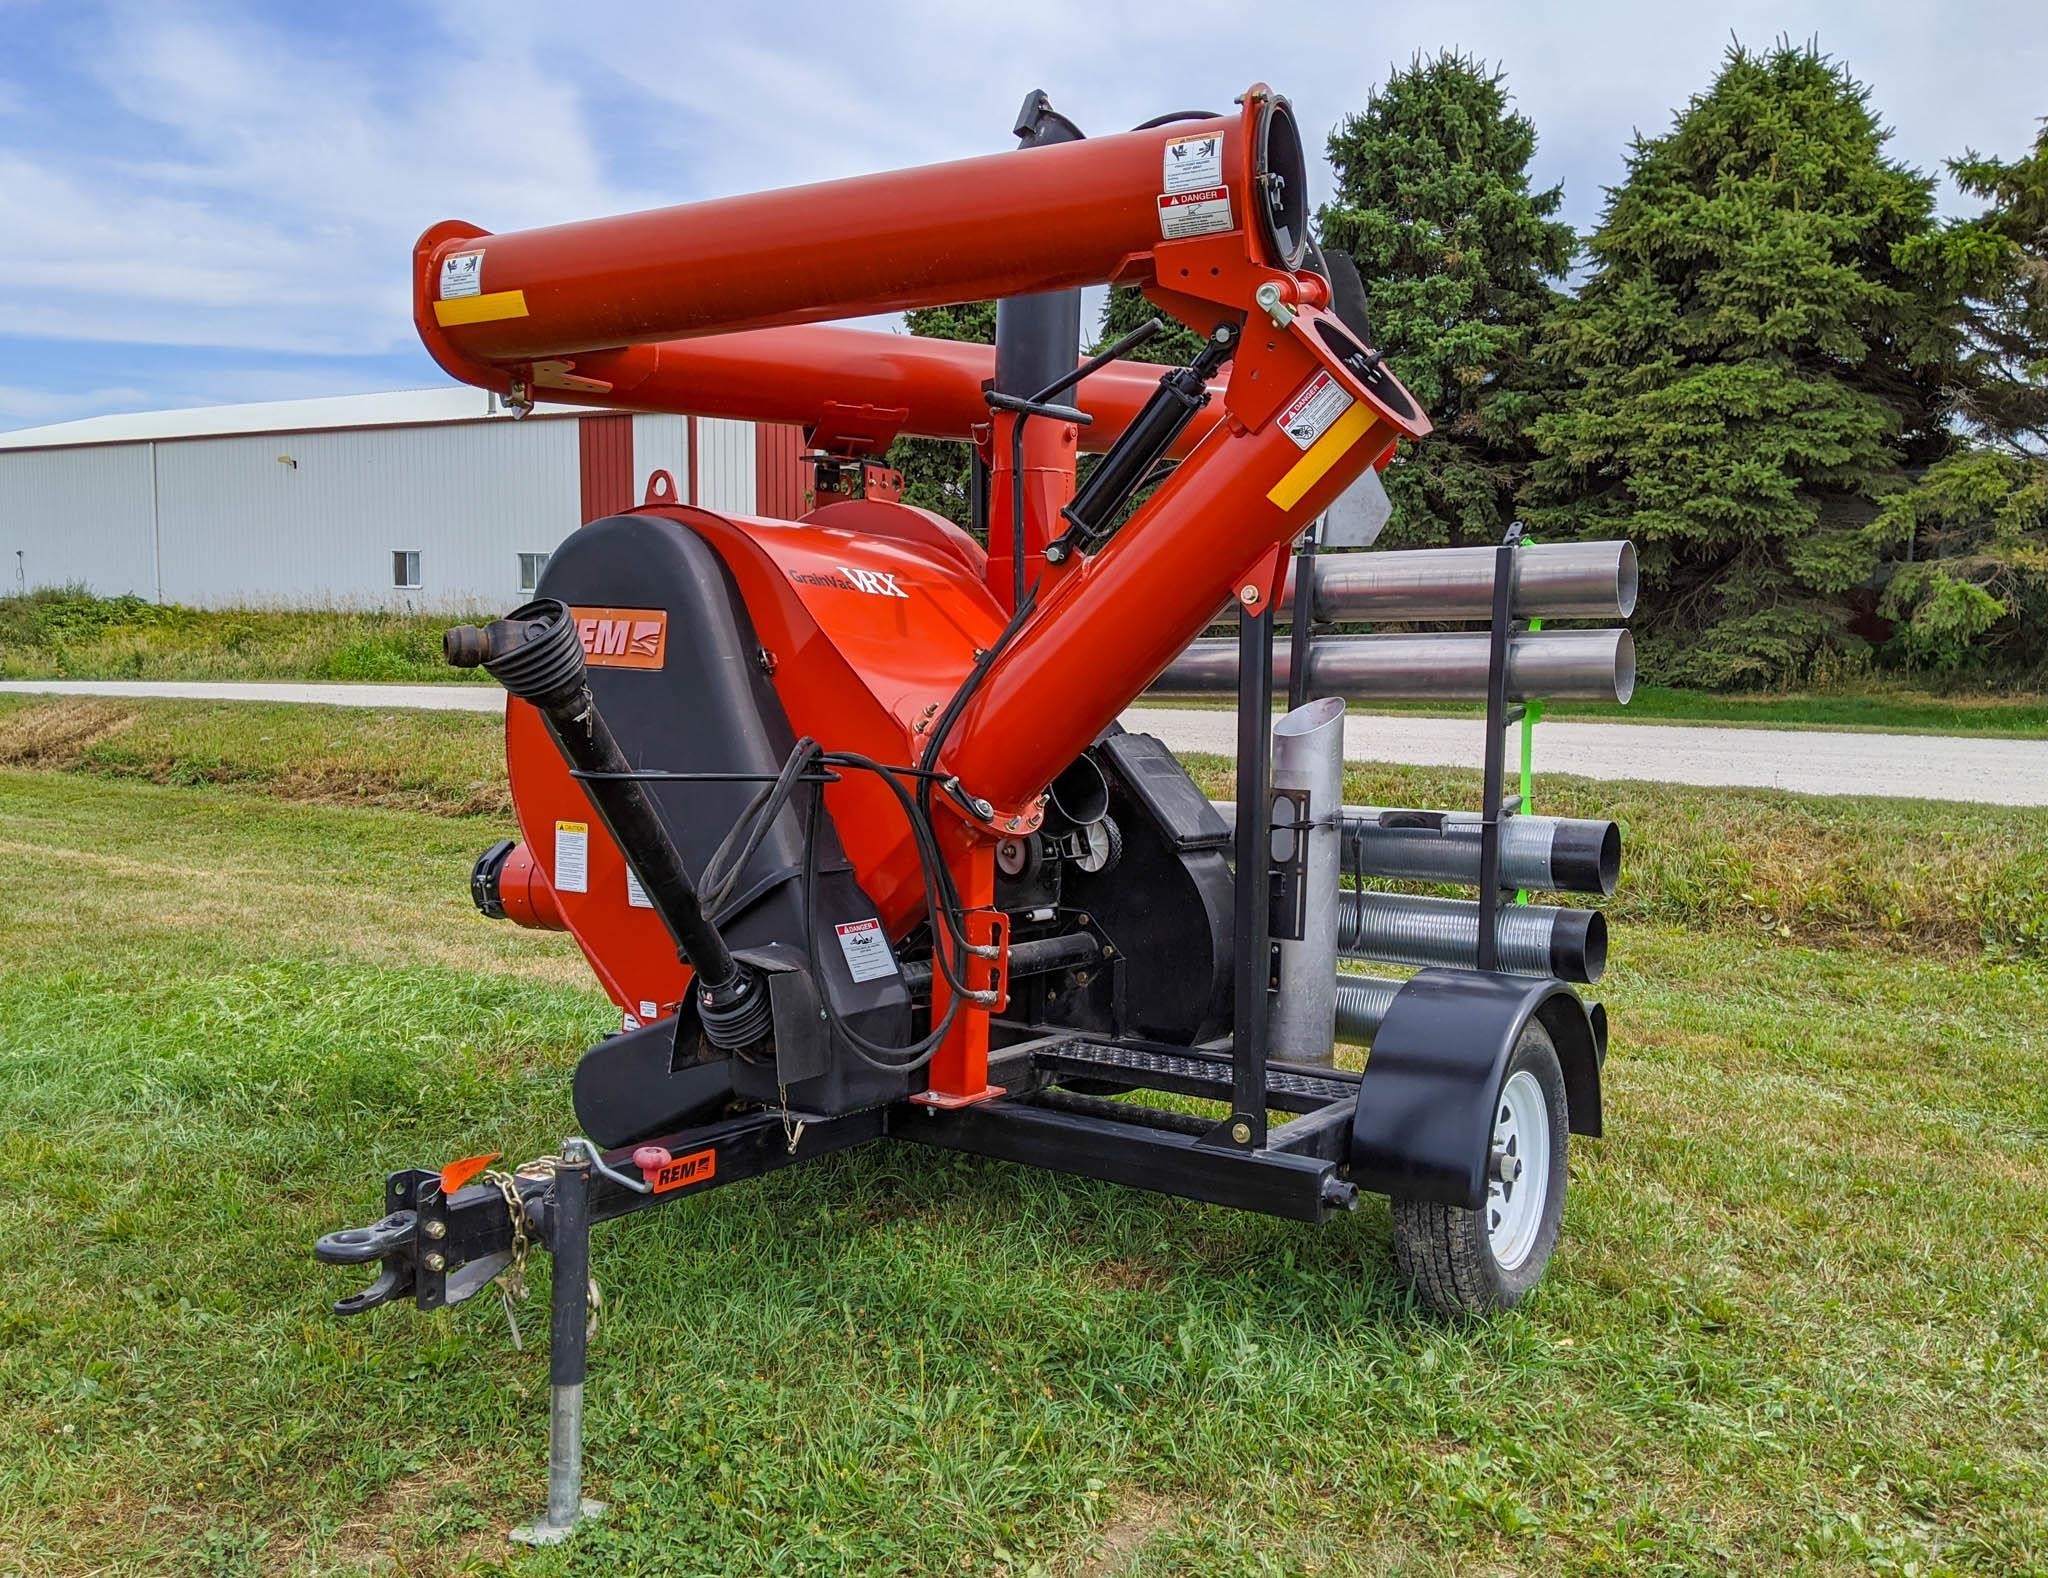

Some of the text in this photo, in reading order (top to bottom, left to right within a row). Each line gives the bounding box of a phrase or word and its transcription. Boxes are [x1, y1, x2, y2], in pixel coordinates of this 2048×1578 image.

[1181, 191, 1218, 203] DANGER
[1293, 384, 1320, 412] DANGER
[788, 566, 910, 598] GrainVac VRX
[574, 618, 632, 655] EM
[849, 922, 873, 933] DANGER
[658, 1160, 697, 1186] REM
